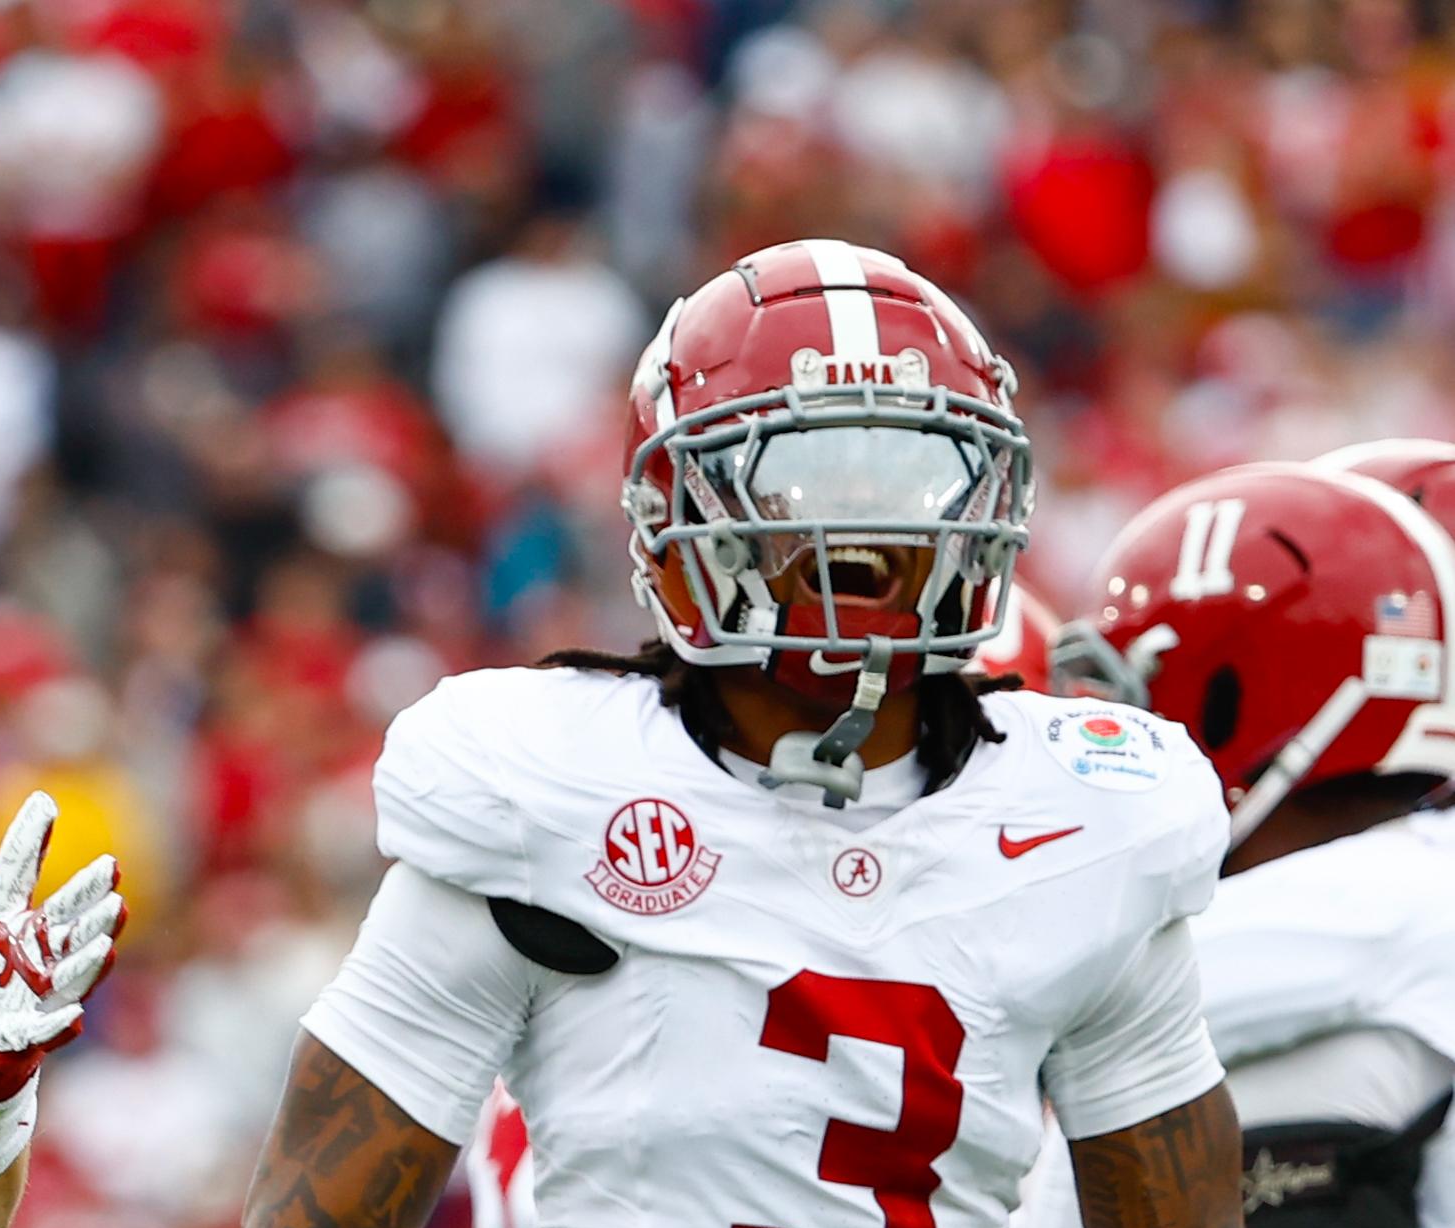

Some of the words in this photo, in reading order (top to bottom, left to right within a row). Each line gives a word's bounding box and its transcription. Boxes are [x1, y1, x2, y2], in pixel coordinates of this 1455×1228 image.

[826, 362, 894, 385] BAMA
[1168, 498, 1246, 600] 11
[608, 801, 691, 883] SEC
[605, 870, 705, 912] GRADUATE
[841, 856, 871, 888] A
